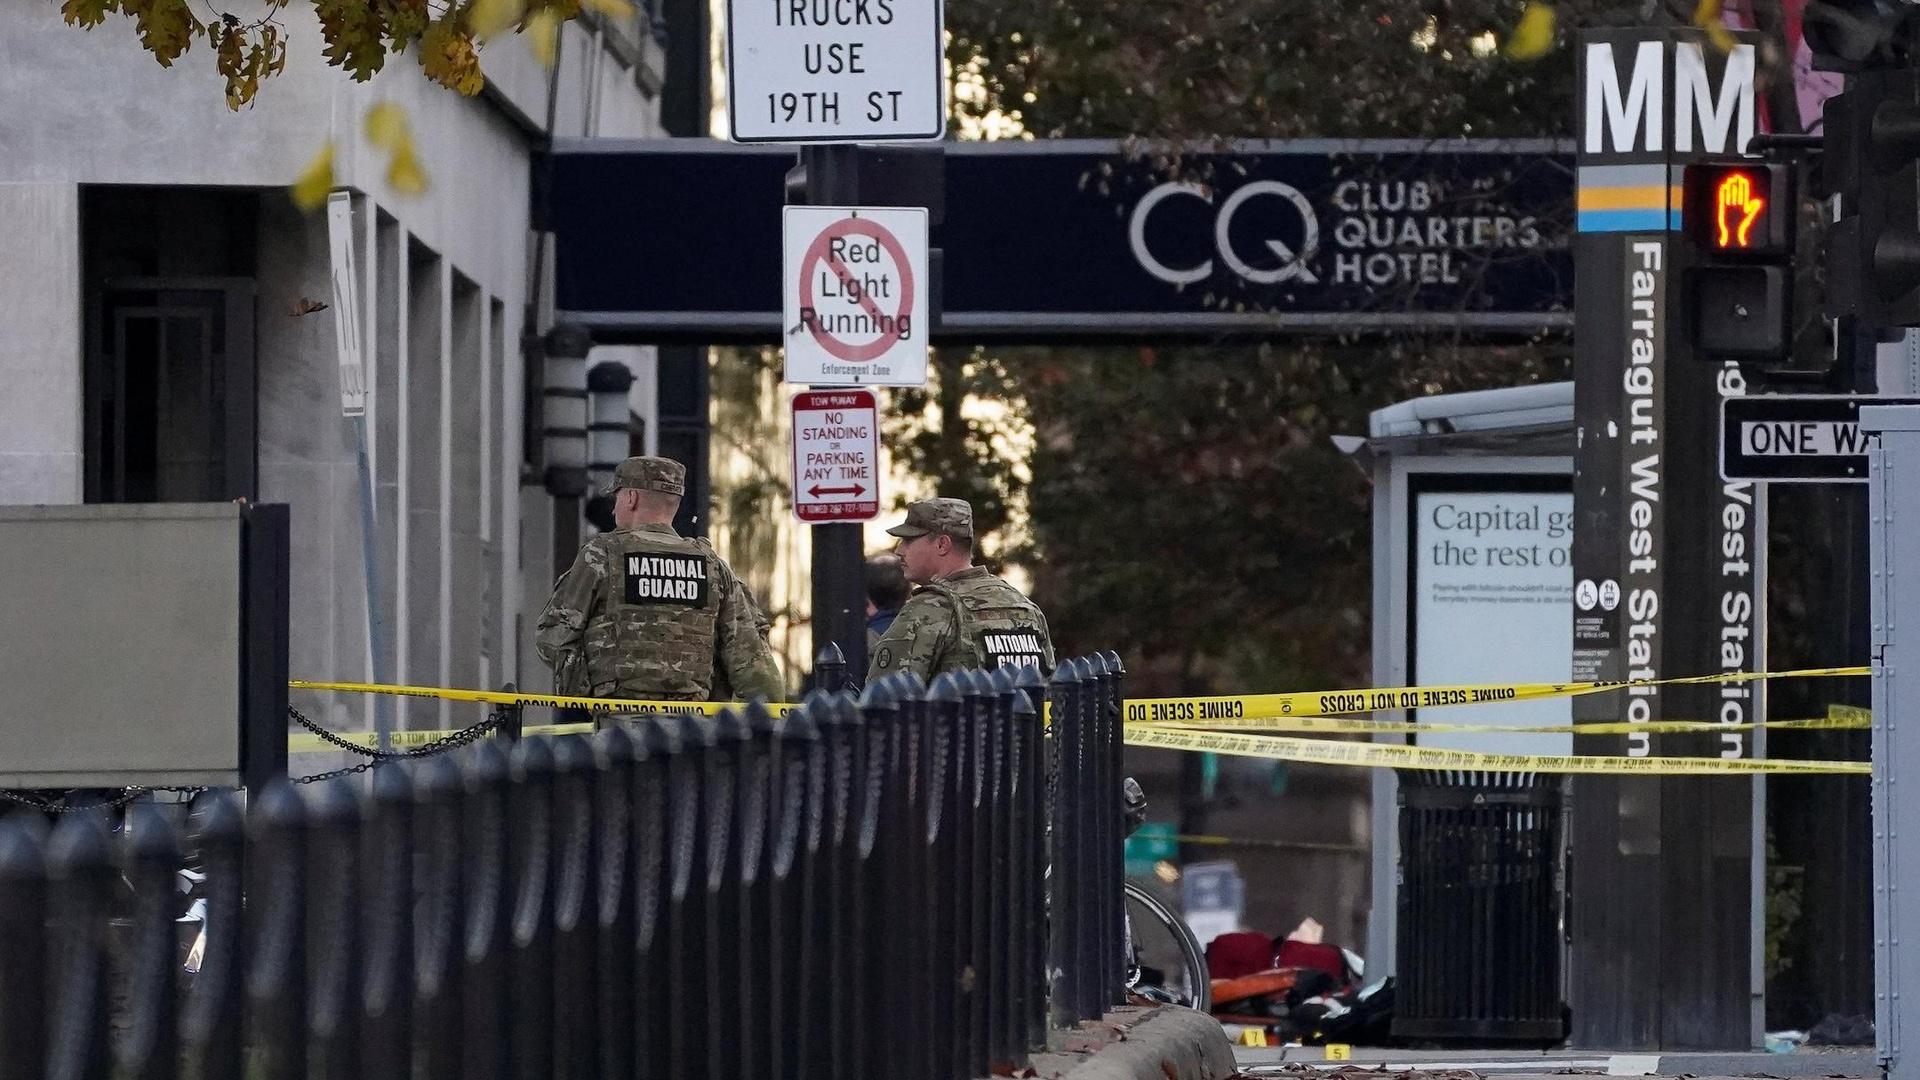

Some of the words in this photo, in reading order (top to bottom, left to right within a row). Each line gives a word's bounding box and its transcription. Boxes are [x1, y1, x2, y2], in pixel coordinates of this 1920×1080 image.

[775, 0, 894, 26] TRUCKS
[804, 43, 865, 74] USE
[768, 92, 839, 124] 19TH
[866, 91, 903, 123] ST
[1585, 41, 1664, 154] M
[1674, 41, 1755, 154] M
[1334, 181, 1432, 212] CLUB
[1128, 180, 1320, 285] CQ
[1334, 216, 1539, 249] QUARTERS
[829, 236, 881, 264] Red
[1334, 253, 1460, 284] HOTEL
[821, 271, 890, 305] Light
[799, 306, 912, 341] Running
[1623, 241, 1662, 445] Farragut
[821, 362, 870, 376] Enforcement
[872, 364, 891, 376] Zone
[825, 412, 844, 425] NO
[802, 426, 868, 441] STANDING
[1750, 423, 1818, 454] ONE
[807, 452, 865, 465] PARKING
[803, 467, 833, 481] ANY
[839, 466, 869, 479] TIME
[1432, 504, 1540, 537] Capital
[1628, 453, 1660, 574] West
[1432, 540, 1478, 567] the
[1486, 544, 1542, 567] rest
[628, 557, 706, 580] NATIONAL
[638, 578, 698, 600] GUARD
[984, 634, 1042, 654] NATIONAL
[1320, 694, 1365, 714] CROSS
[1369, 692, 1396, 711] NOT
[1400, 691, 1419, 709] DO
[1423, 689, 1467, 707] SCENE
[1471, 687, 1515, 703] CRIME
[1127, 703, 1147, 721] DO
[1150, 702, 1195, 721] SCENE
[1198, 700, 1244, 719] CRIME
[1333, 1048, 1342, 1060] 5
